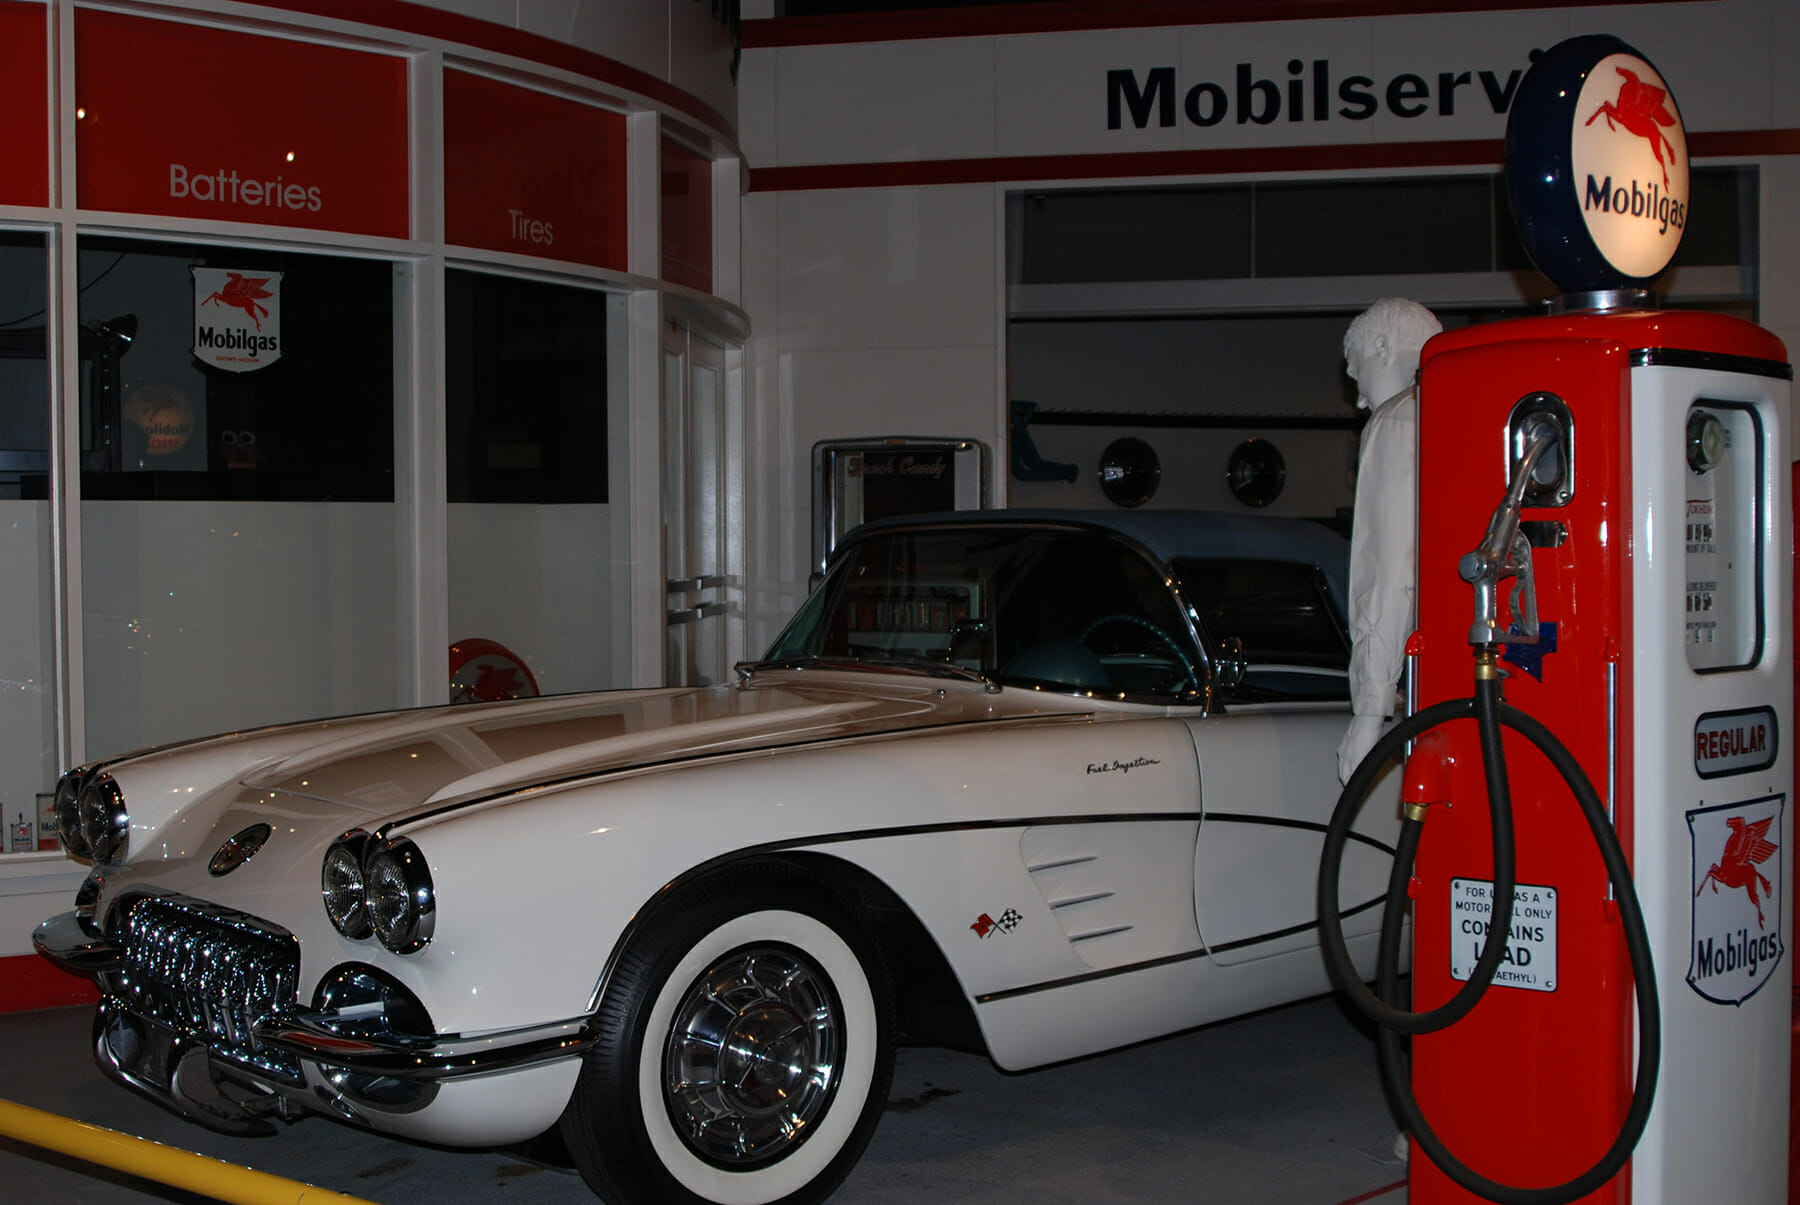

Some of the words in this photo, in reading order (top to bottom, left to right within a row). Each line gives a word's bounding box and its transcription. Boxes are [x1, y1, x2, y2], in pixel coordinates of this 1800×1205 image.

[1107, 49, 1544, 130] Mobilserv
[169, 163, 323, 212] Batteries
[1585, 174, 1686, 236] Mobilgas
[508, 208, 554, 245] Tires
[199, 326, 277, 357] Mobilgas
[1697, 724, 1766, 761] REGULAR
[1456, 901, 1491, 913] MOTOR
[1525, 907, 1553, 919] ONLY
[1466, 887, 1486, 898] FOR
[1514, 891, 1529, 902] AS
[1533, 893, 1541, 903] A
[1474, 942, 1531, 967] LAD
[1698, 928, 1777, 980] Mobilgas
